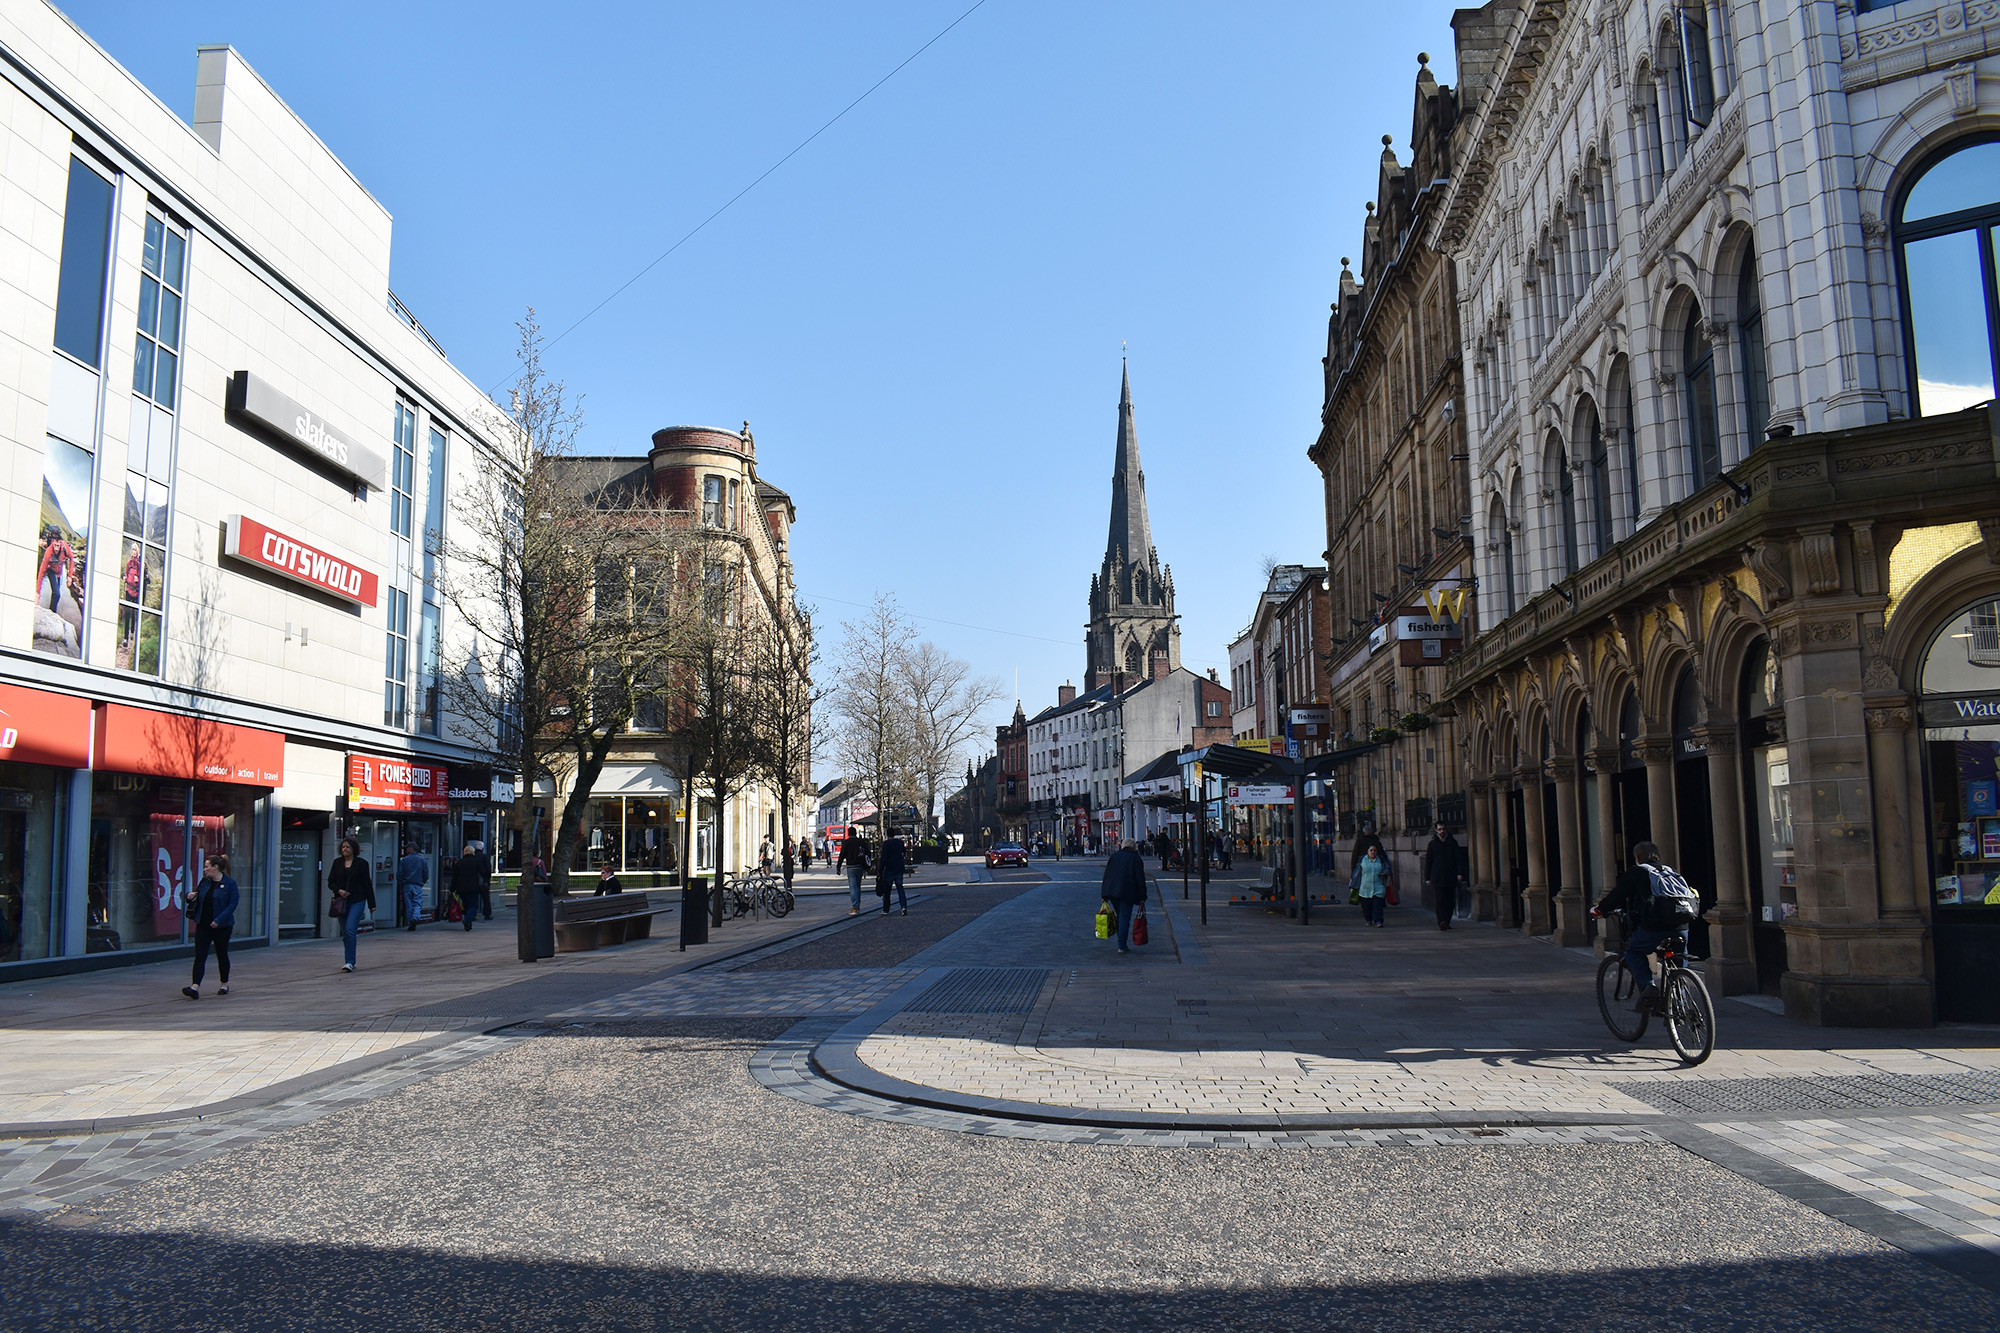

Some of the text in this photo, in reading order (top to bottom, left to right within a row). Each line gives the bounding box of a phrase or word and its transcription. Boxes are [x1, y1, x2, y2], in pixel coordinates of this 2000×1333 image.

[294, 412, 348, 465] slaters
[261, 531, 362, 596] COTSWOLD
[1417, 587, 1472, 624] W
[1407, 622, 1453, 632] fishers
[0, 727, 18, 749] D
[204, 765, 279, 781] outdoor action travel
[379, 763, 412, 785] FONES
[412, 768, 431, 788] HUB
[448, 787, 488, 799] slaters
[1230, 788, 1237, 797] F
[175, 818, 205, 828] COTOLD
[157, 847, 205, 911] Sal
